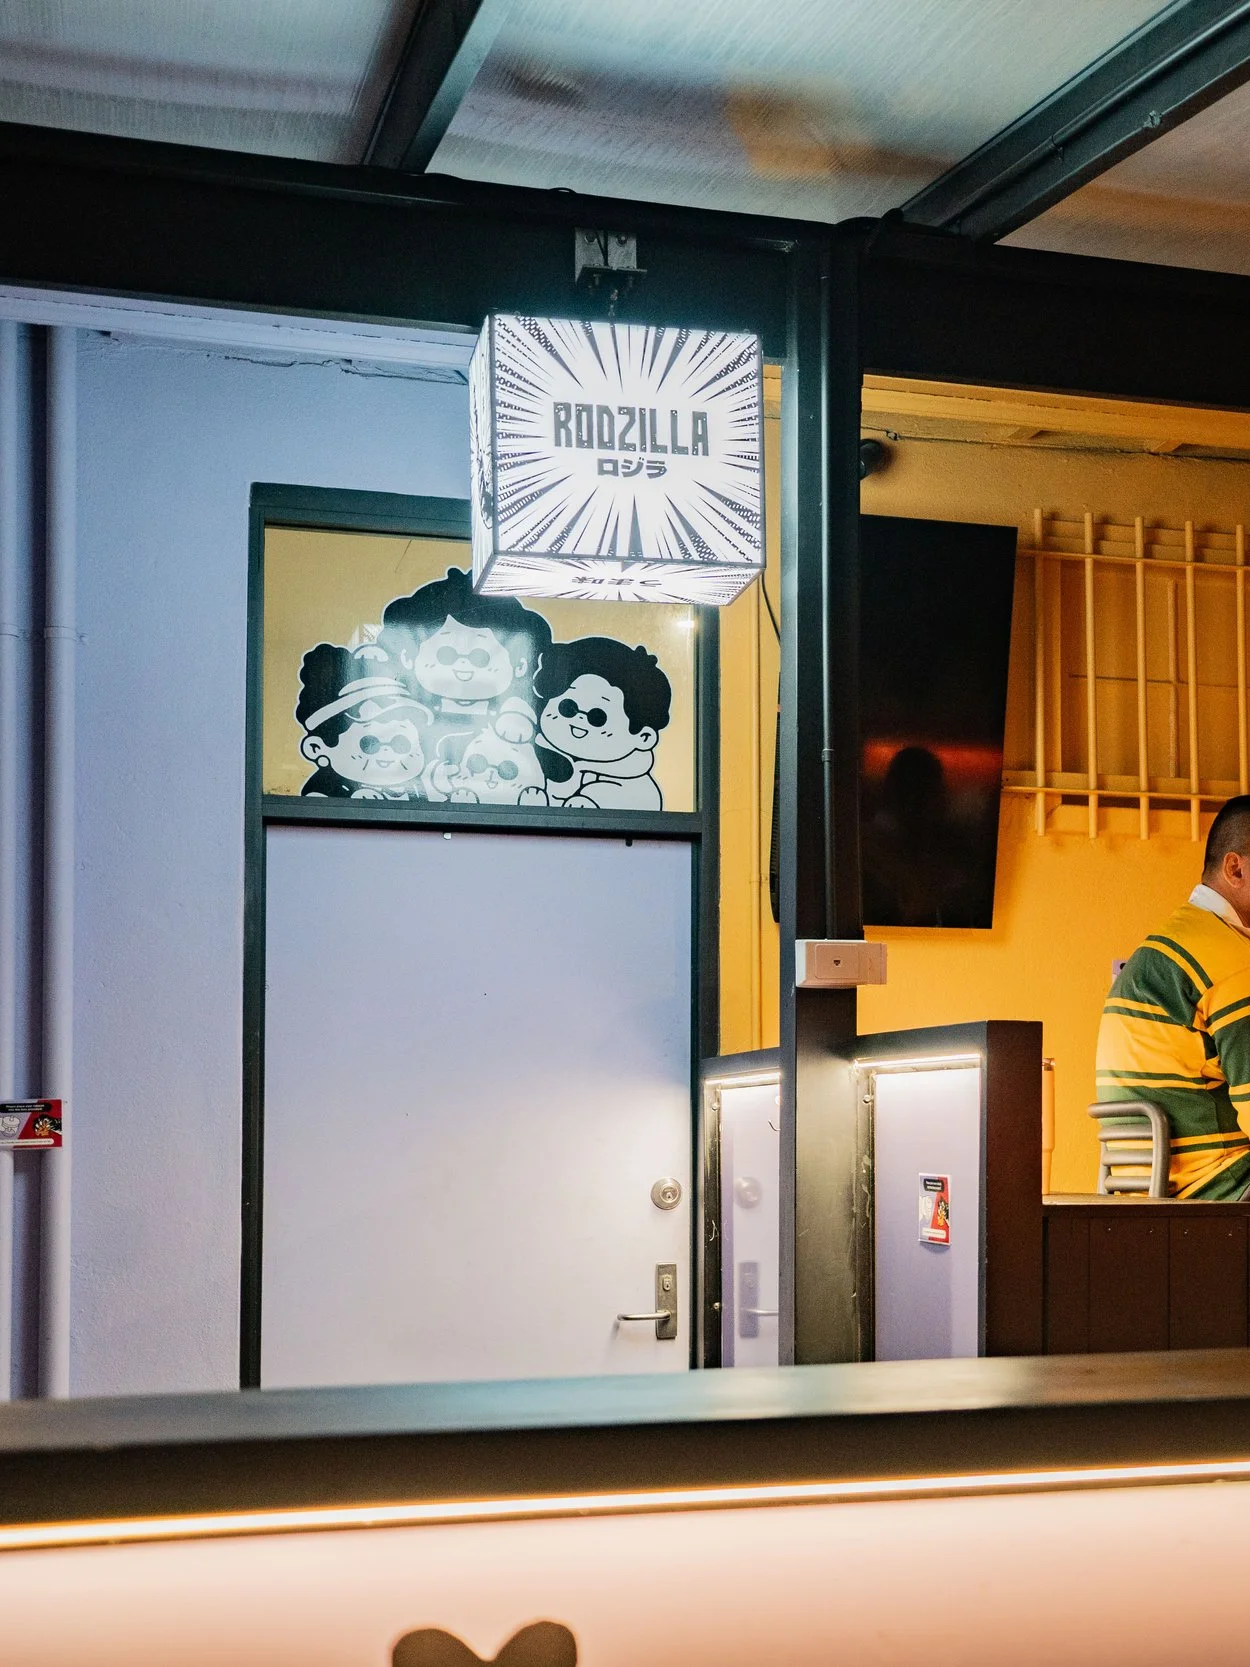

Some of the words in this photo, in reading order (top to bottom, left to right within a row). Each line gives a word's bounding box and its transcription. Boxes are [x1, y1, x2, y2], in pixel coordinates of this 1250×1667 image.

[552, 401, 710, 457] RODZILLA
[597, 457, 668, 479] ロジラ
